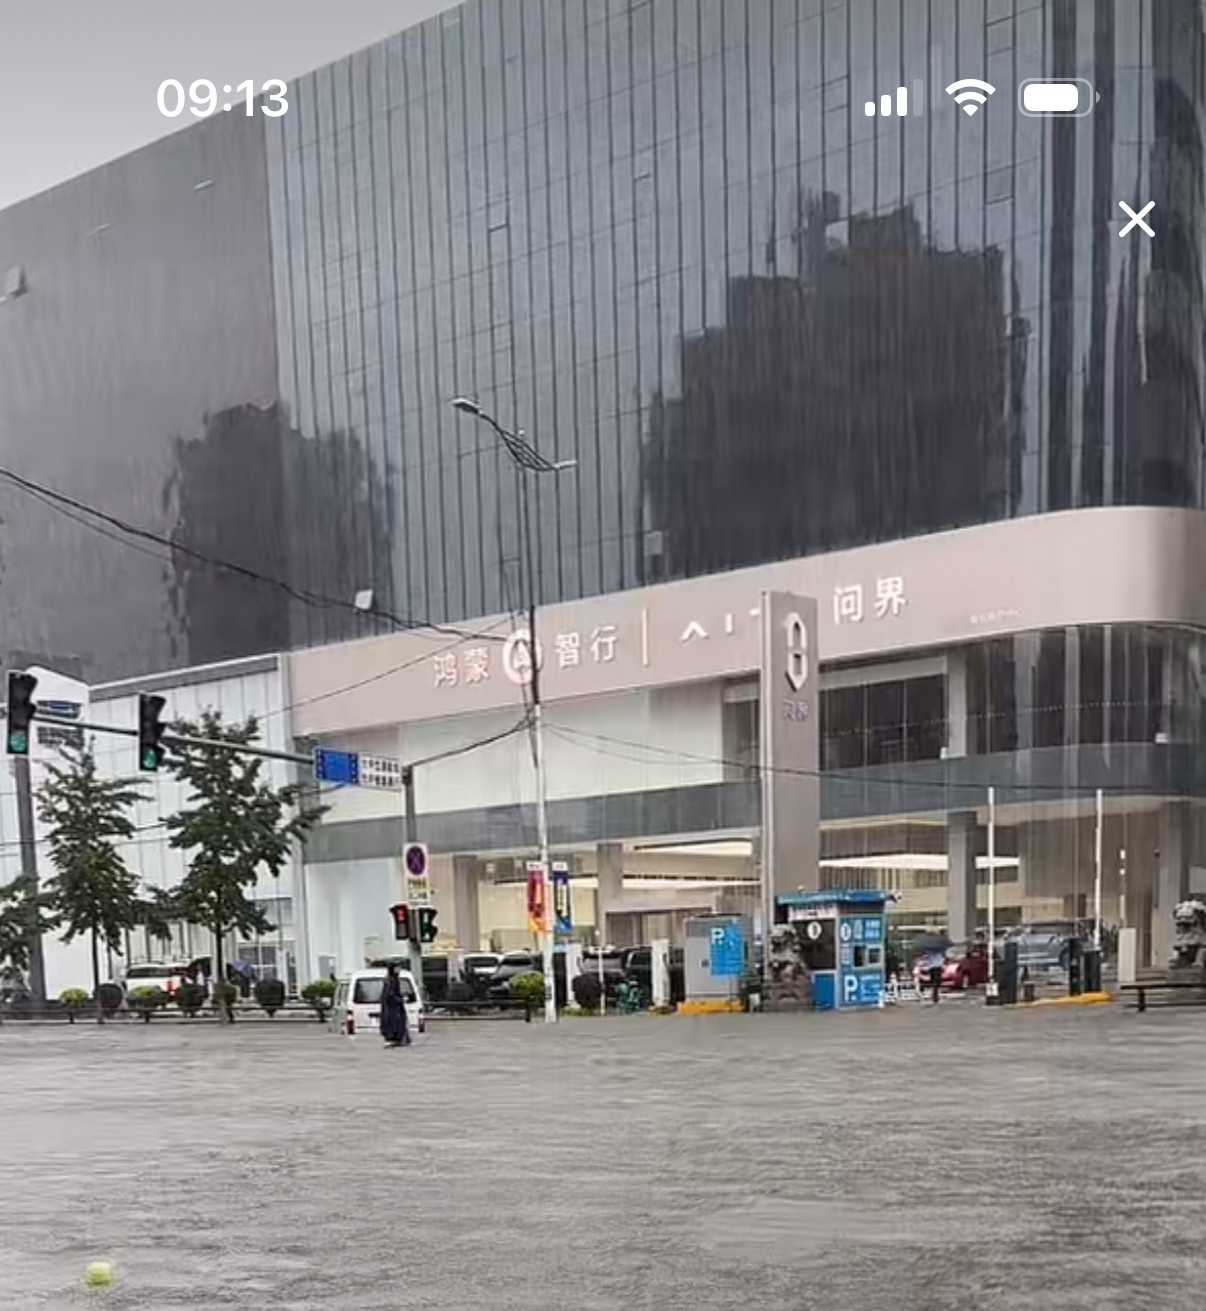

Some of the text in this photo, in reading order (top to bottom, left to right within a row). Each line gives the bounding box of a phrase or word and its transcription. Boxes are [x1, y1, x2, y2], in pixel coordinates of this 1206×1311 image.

[434, 647, 490, 687] 鸿蒙
[555, 625, 617, 668] 智行
[833, 576, 907, 625] 问界
